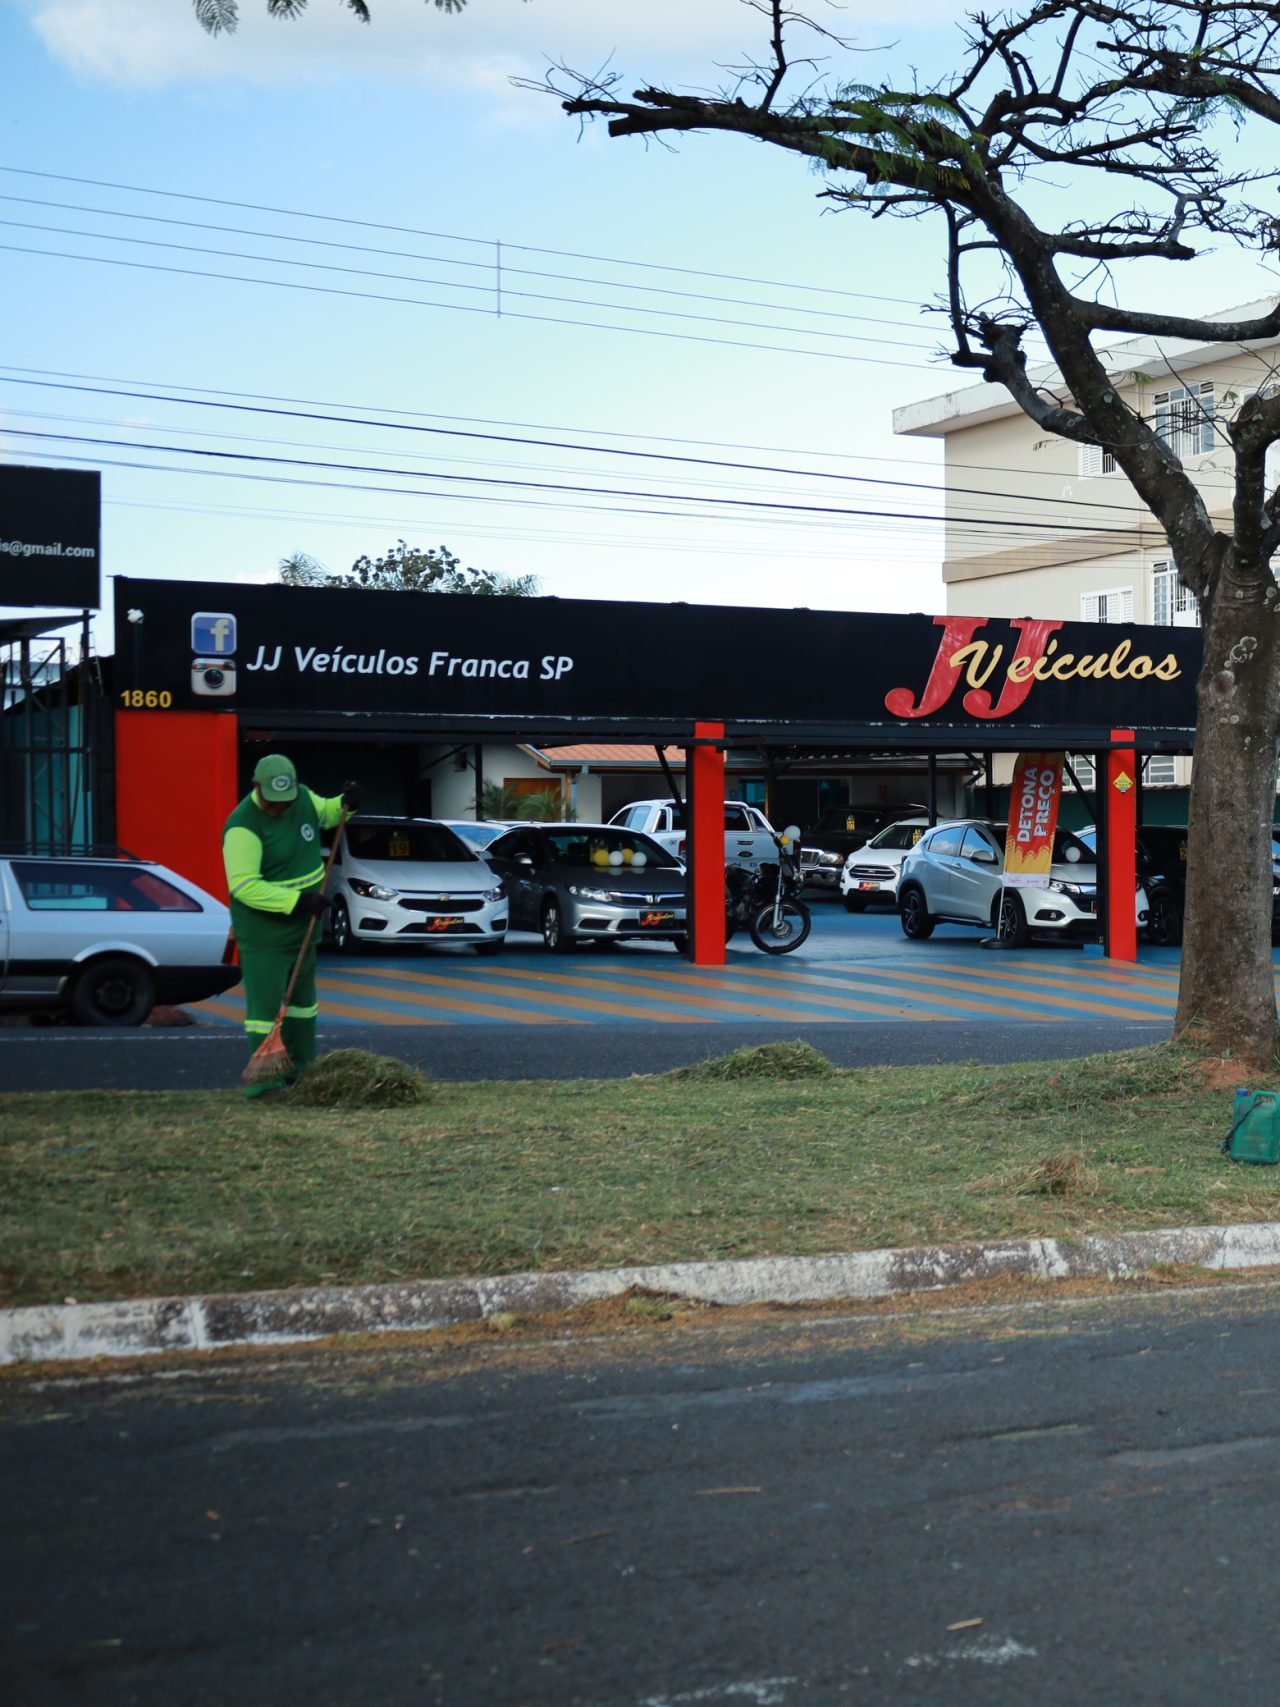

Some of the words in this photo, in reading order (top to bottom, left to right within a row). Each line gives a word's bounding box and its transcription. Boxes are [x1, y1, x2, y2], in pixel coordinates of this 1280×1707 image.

[246, 645, 283, 672] JJ
[295, 646, 420, 676] Veículos
[428, 651, 530, 679] Franca
[540, 655, 575, 681] SP
[885, 616, 1064, 719] JJ
[120, 689, 173, 709] 1860
[1016, 767, 1039, 843] DETONA
[1033, 769, 1058, 837] PREÇO
